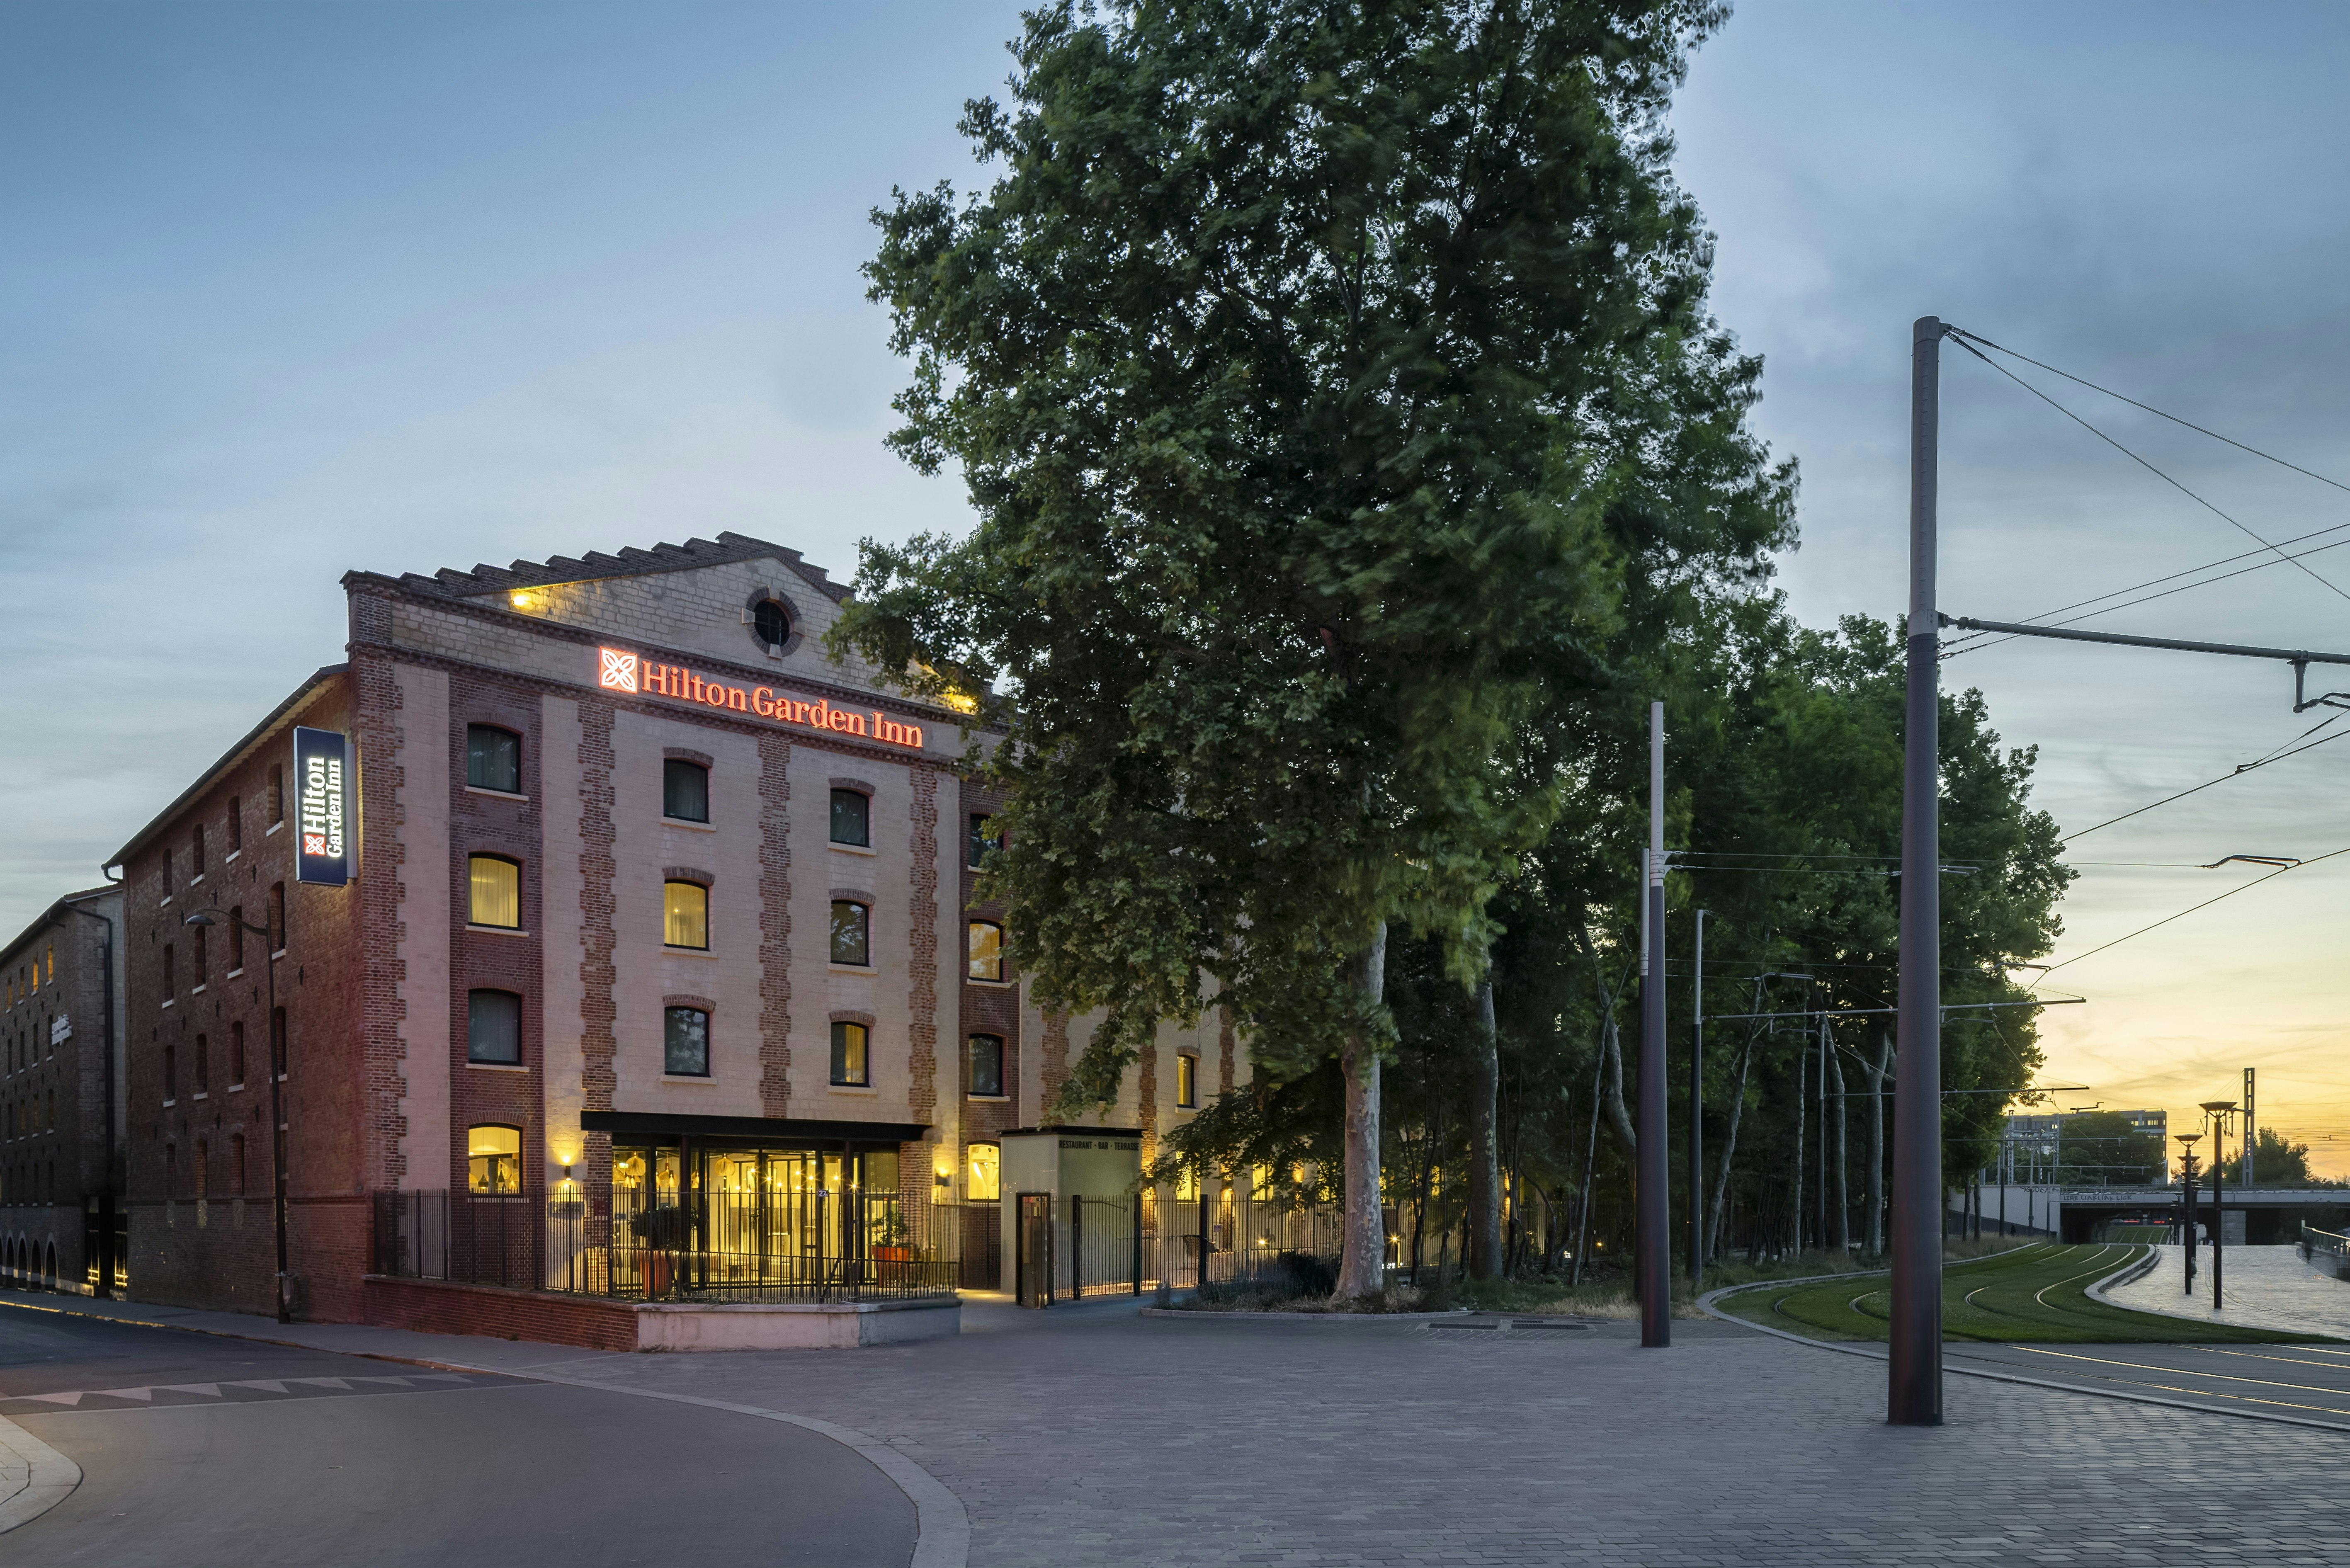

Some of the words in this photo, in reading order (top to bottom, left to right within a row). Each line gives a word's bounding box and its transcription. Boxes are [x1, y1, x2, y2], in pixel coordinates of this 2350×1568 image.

[642, 660, 747, 711] Hilton
[751, 687, 866, 736] Garden
[872, 712, 922, 748] Inn
[303, 756, 325, 835] Hilton
[326, 759, 341, 792] Inn
[326, 793, 342, 858] Garden
[1059, 1141, 1092, 1149] RESTAURANT
[1114, 1142, 1139, 1151] TERRASSE
